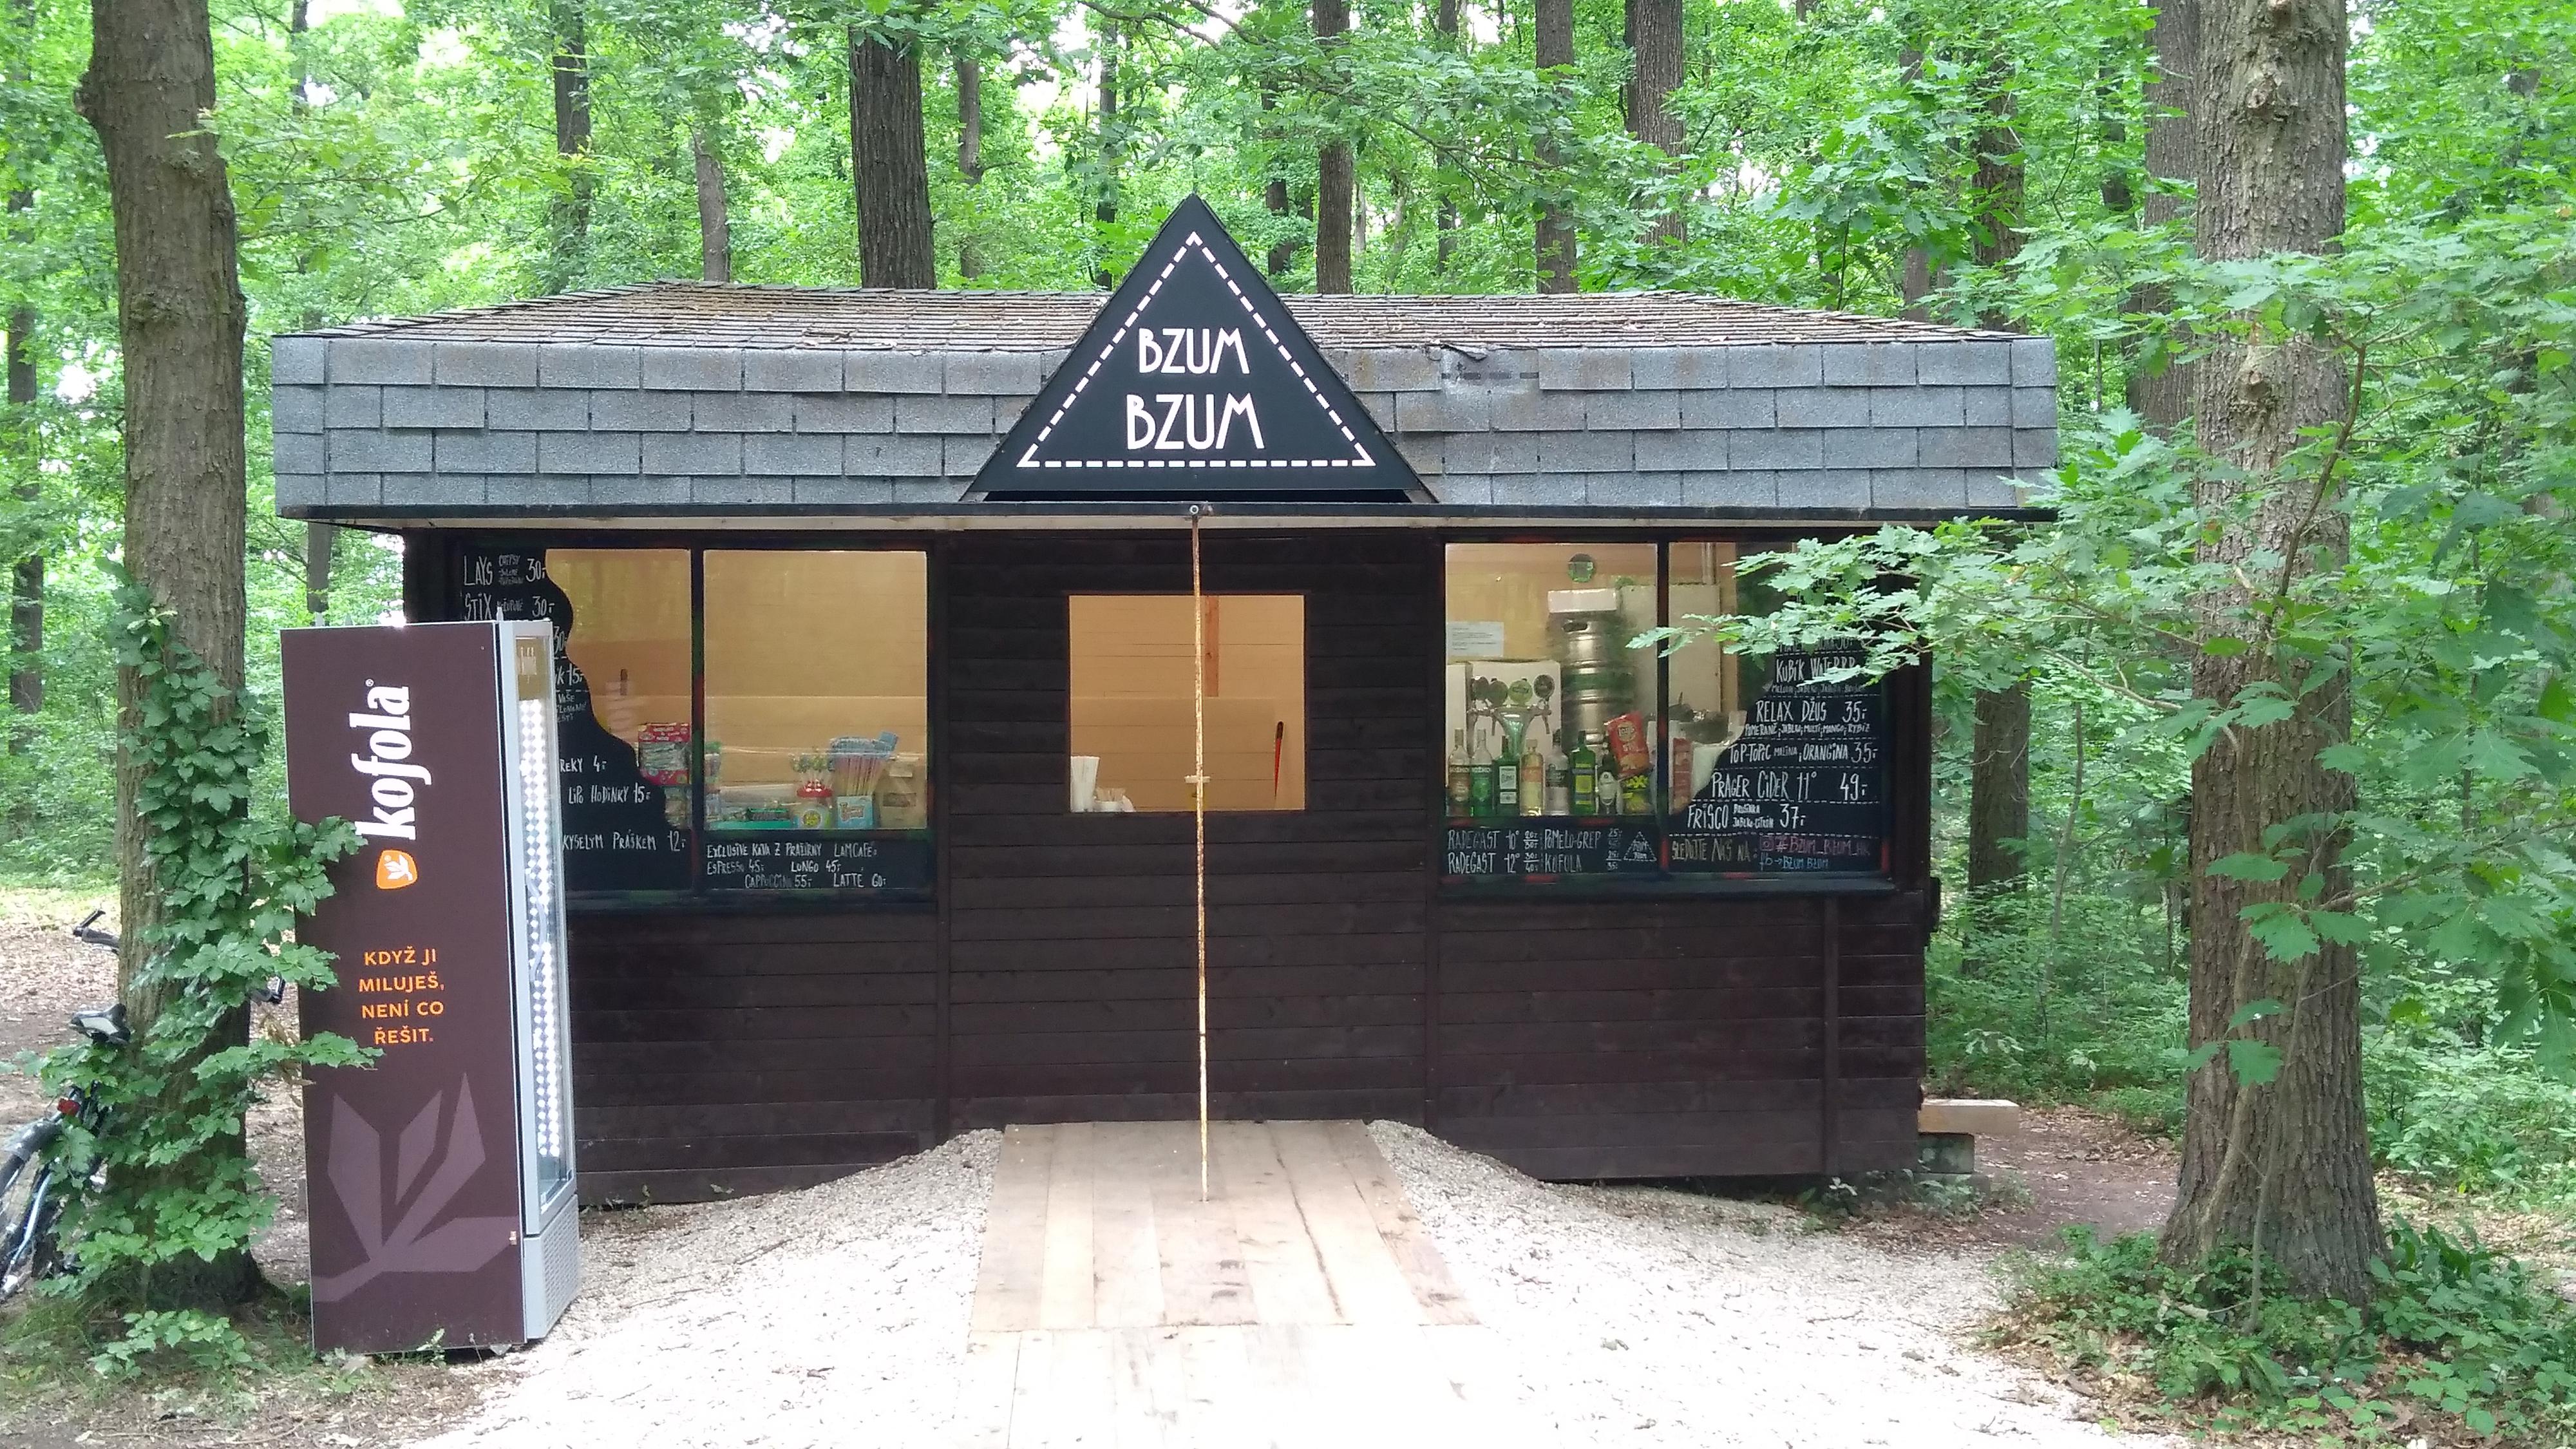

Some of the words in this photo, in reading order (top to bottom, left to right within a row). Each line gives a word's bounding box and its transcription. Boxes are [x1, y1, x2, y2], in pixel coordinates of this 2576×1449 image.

[1139, 327, 1250, 374] BZUM
[1126, 392, 1265, 450] BZUM
[1756, 700, 1794, 723] RELAX
[348, 686, 431, 840] kofola
[1711, 772, 1750, 799] PRAGER
[1687, 803, 1728, 829] FRISCO
[1448, 829, 1501, 849] RADEGAST
[790, 860, 819, 873] LUNGO
[1448, 851, 1497, 874] RADEGAST
[364, 945, 416, 966] KDYŽ
[421, 948, 437, 966] JI
[359, 971, 444, 992] MILUJEŠ,
[361, 999, 410, 1019] NENÍ
[417, 1001, 444, 1016] CO
[374, 1025, 434, 1045] ŘEŠIT.
